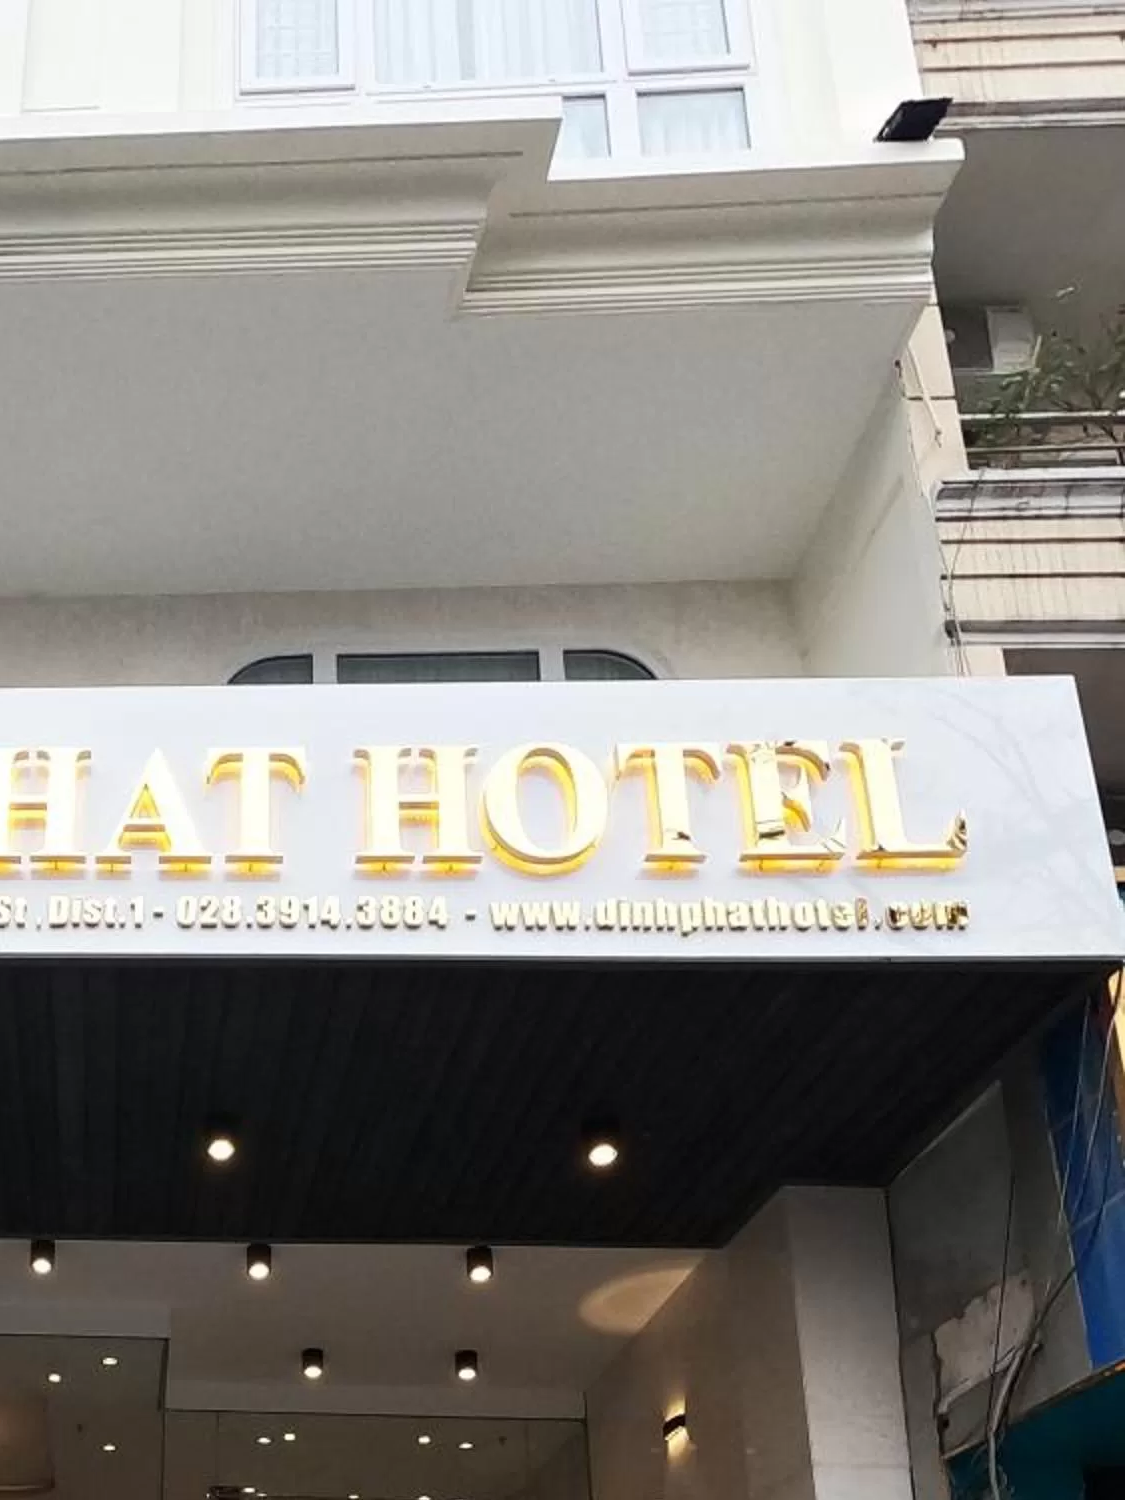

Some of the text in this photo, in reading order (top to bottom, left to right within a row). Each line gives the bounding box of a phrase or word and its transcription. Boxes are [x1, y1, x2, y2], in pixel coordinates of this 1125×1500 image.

[353, 738, 969, 872] HOTEL
[176, 895, 449, 930] 028.3914.3884
[490, 896, 970, 936] www.dinhphathotel.com
